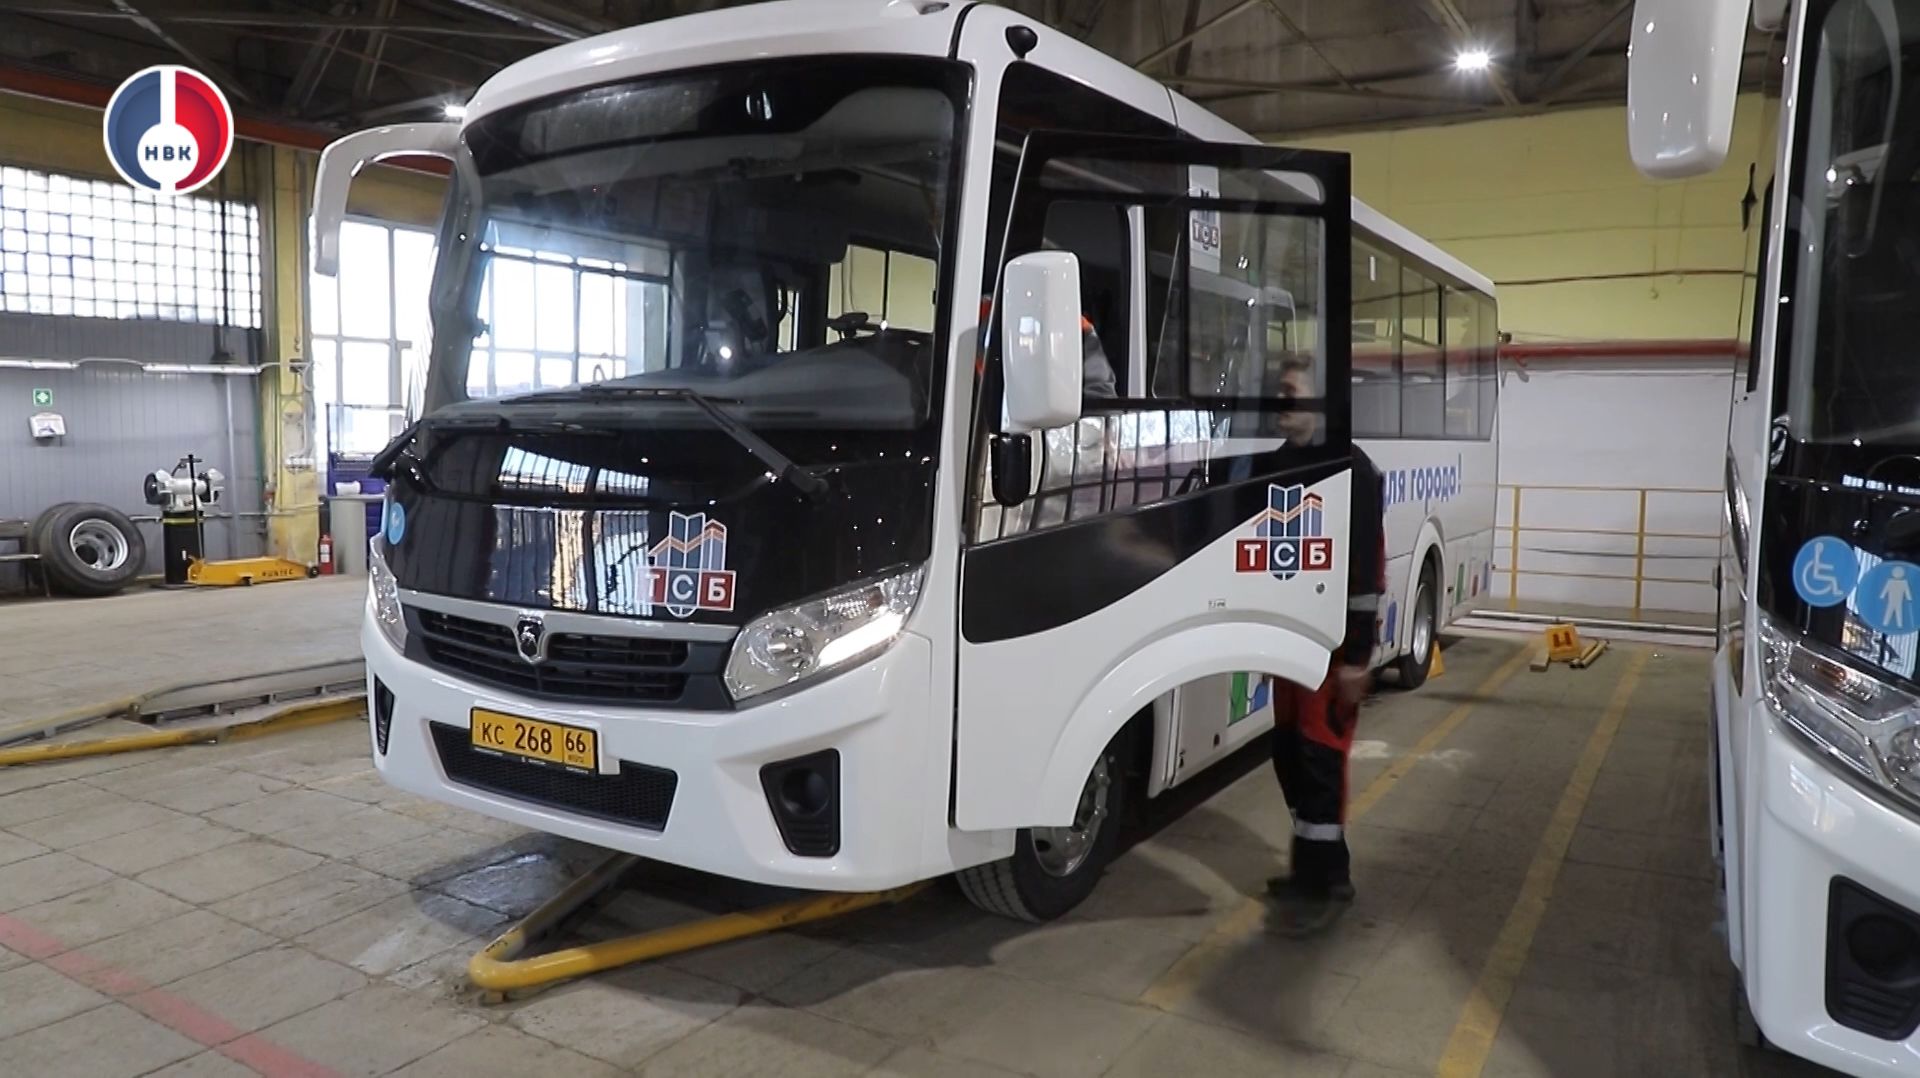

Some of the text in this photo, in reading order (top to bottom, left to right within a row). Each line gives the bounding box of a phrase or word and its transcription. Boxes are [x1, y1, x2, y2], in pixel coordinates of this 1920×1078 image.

[1411, 453, 1462, 515] города!
[1243, 542, 1327, 567] ТСБ
[644, 572, 727, 602] ТСБ
[481, 722, 505, 745] КС
[514, 722, 553, 755] 268
[565, 730, 586, 754] 66
